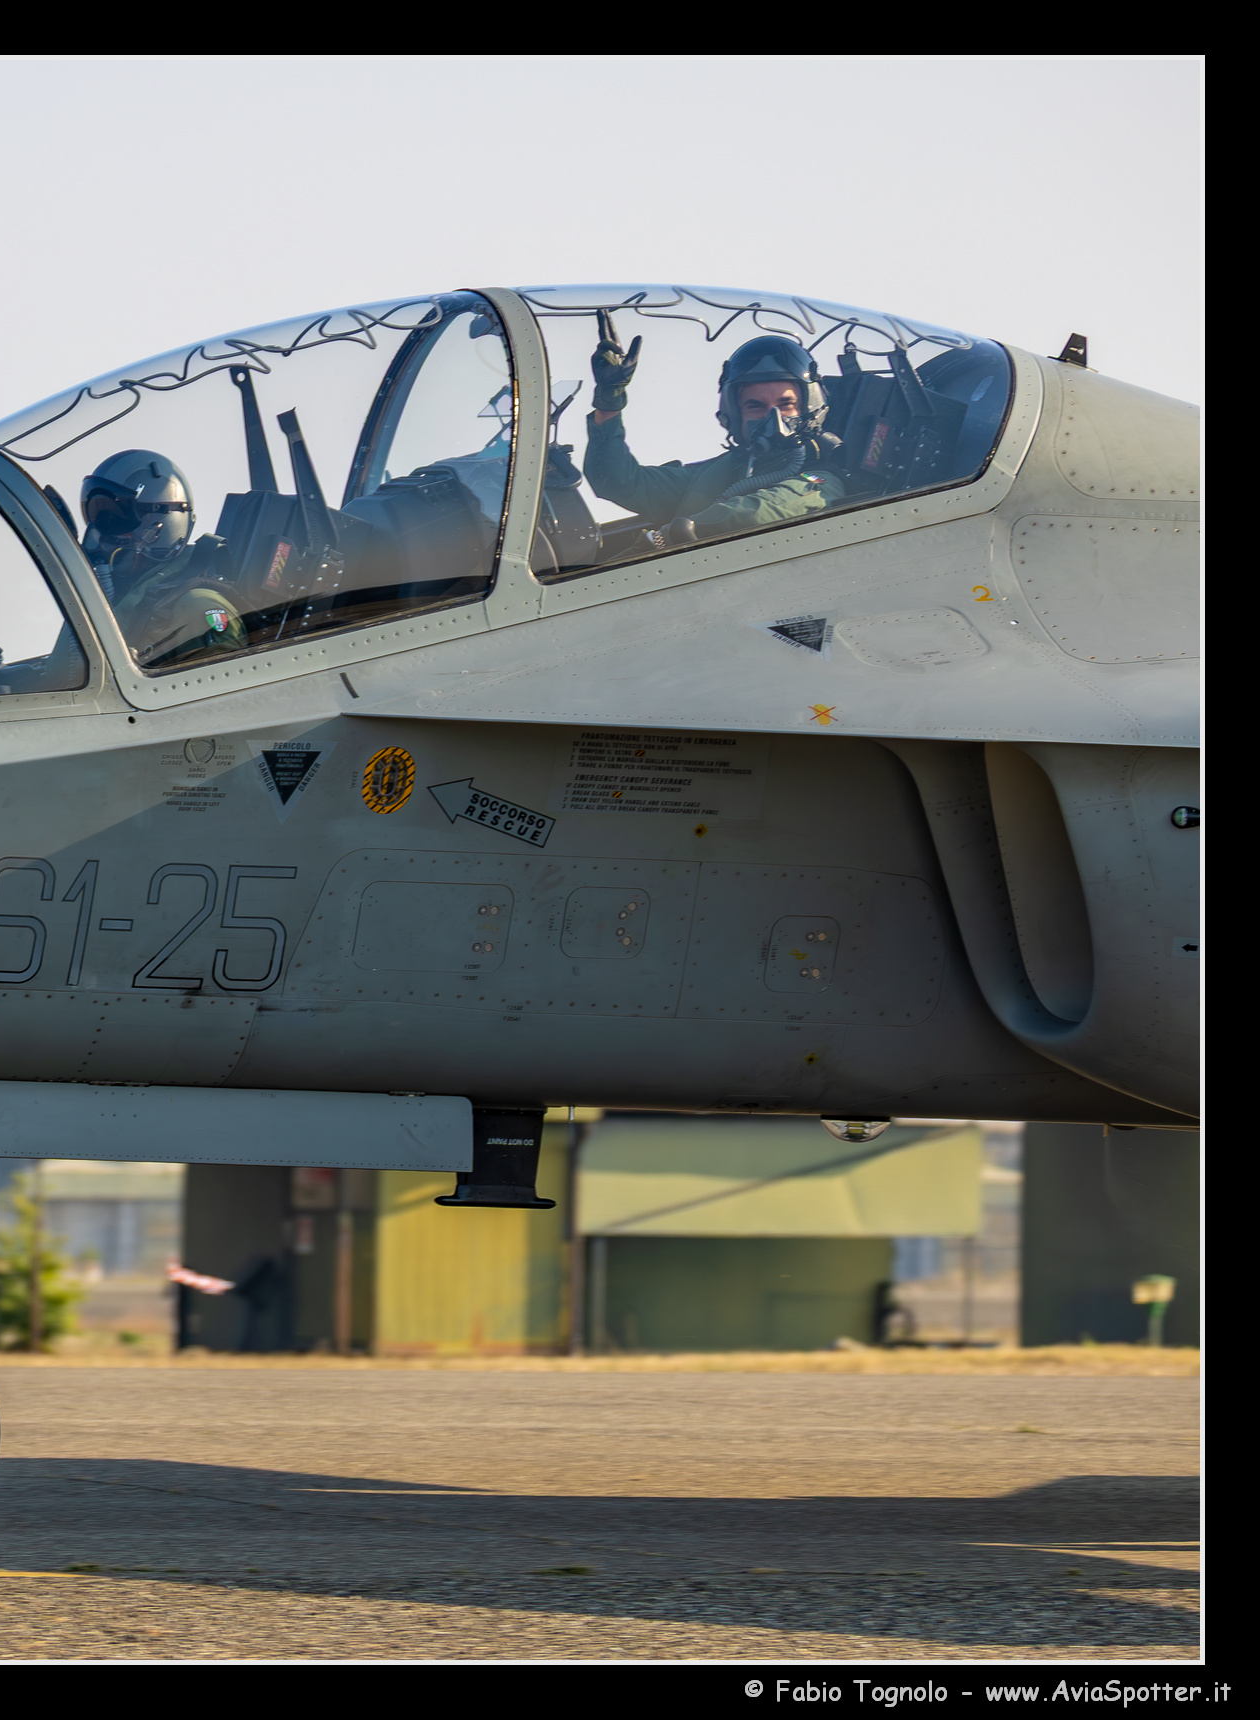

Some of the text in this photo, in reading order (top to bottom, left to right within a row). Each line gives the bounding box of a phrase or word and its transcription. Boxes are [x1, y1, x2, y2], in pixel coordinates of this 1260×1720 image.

[971, 585, 995, 602] 2
[772, 633, 802, 649] DANGER
[273, 742, 311, 750] PERICOLO
[581, 732, 641, 742] FRANTUMAZIONE
[643, 735, 682, 744] TETTUCCIO
[694, 737, 737, 746] EMERGENZA
[258, 762, 276, 792] DANGER
[298, 762, 322, 792] DANGER
[650, 777, 692, 786] SEVERANCE
[470, 793, 546, 830] SOCCORSO
[464, 805, 543, 842] RESCUE
[486, 1138, 535, 1146] DO NOT PAINT
